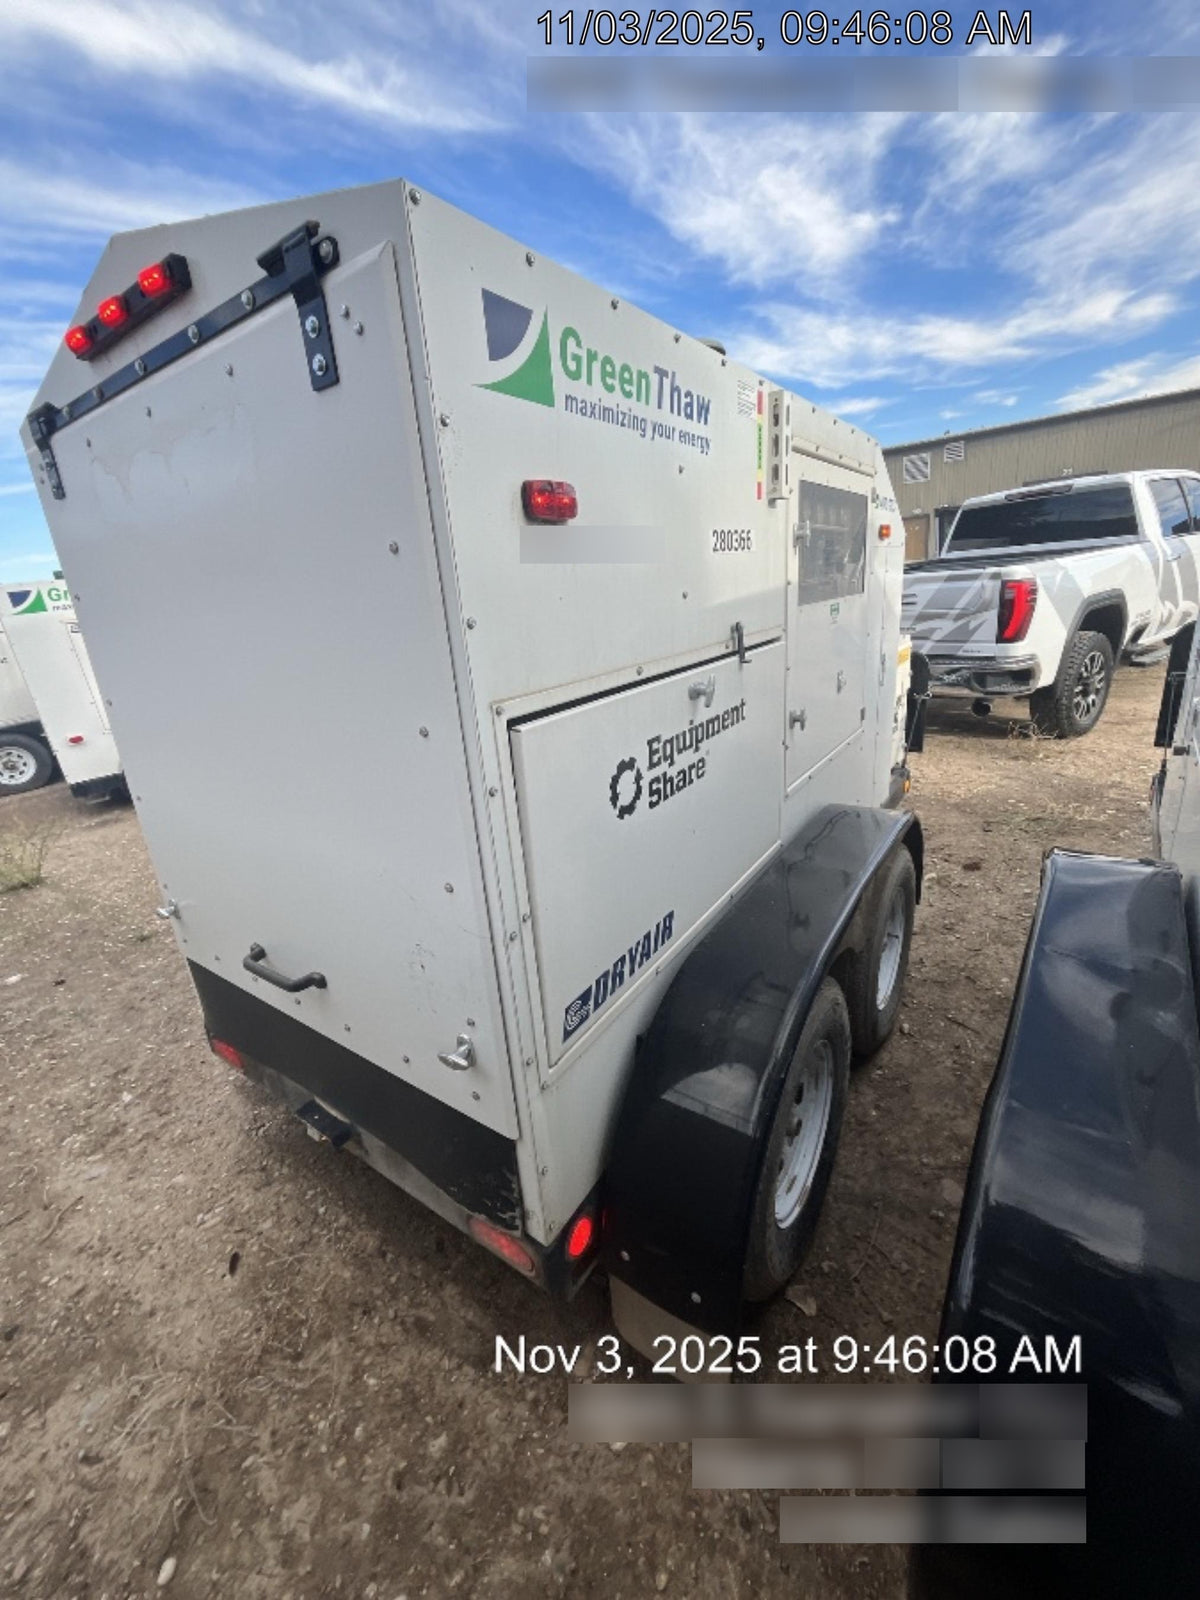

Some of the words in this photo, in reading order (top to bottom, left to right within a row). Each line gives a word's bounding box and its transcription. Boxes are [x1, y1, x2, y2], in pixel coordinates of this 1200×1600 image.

[564, 393, 647, 438] maximizing
[651, 420, 676, 441] your
[678, 429, 711, 455] energy
[647, 699, 747, 772] Equipment
[648, 754, 706, 809] Share
[592, 910, 675, 1013] DRYAIR
